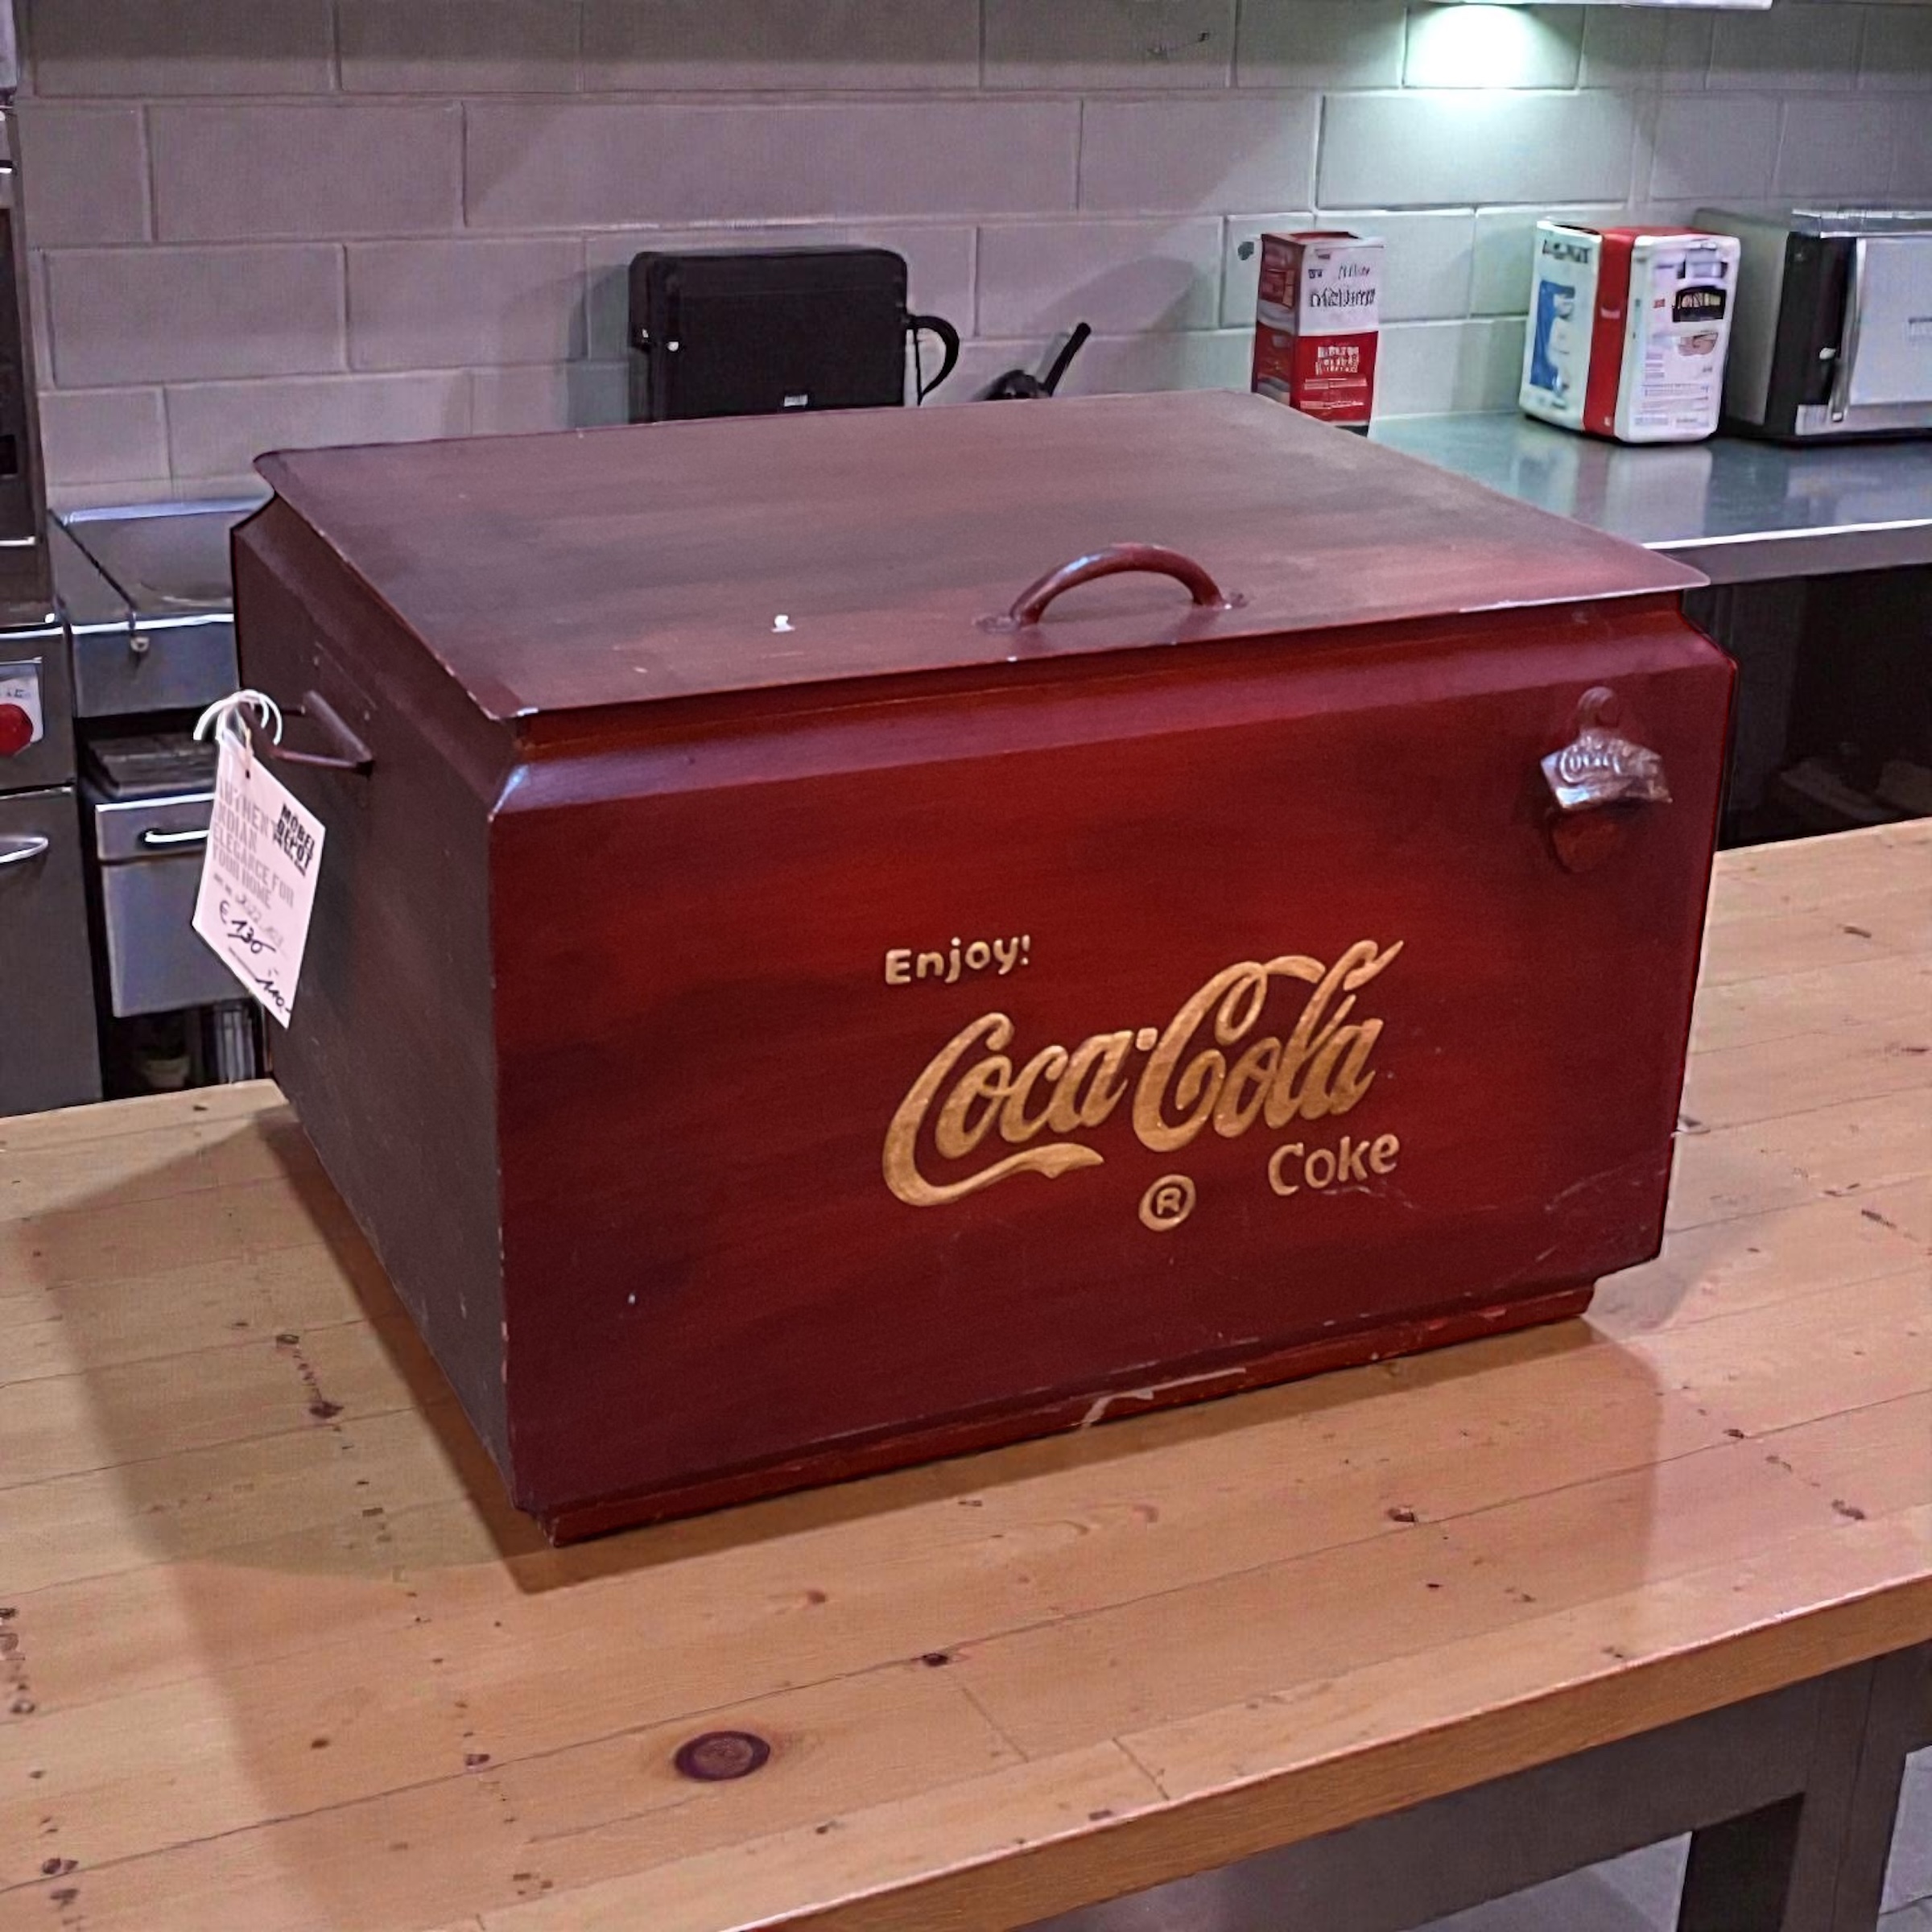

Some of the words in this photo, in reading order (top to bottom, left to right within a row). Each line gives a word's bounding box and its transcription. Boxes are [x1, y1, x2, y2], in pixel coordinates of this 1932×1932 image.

[213, 841, 240, 881] YOUR
[213, 821, 270, 886] ELEGANCE
[272, 873, 295, 908] FOR
[885, 935, 1030, 985] Enjoy!
[1268, 1133, 1400, 1195] Coke
